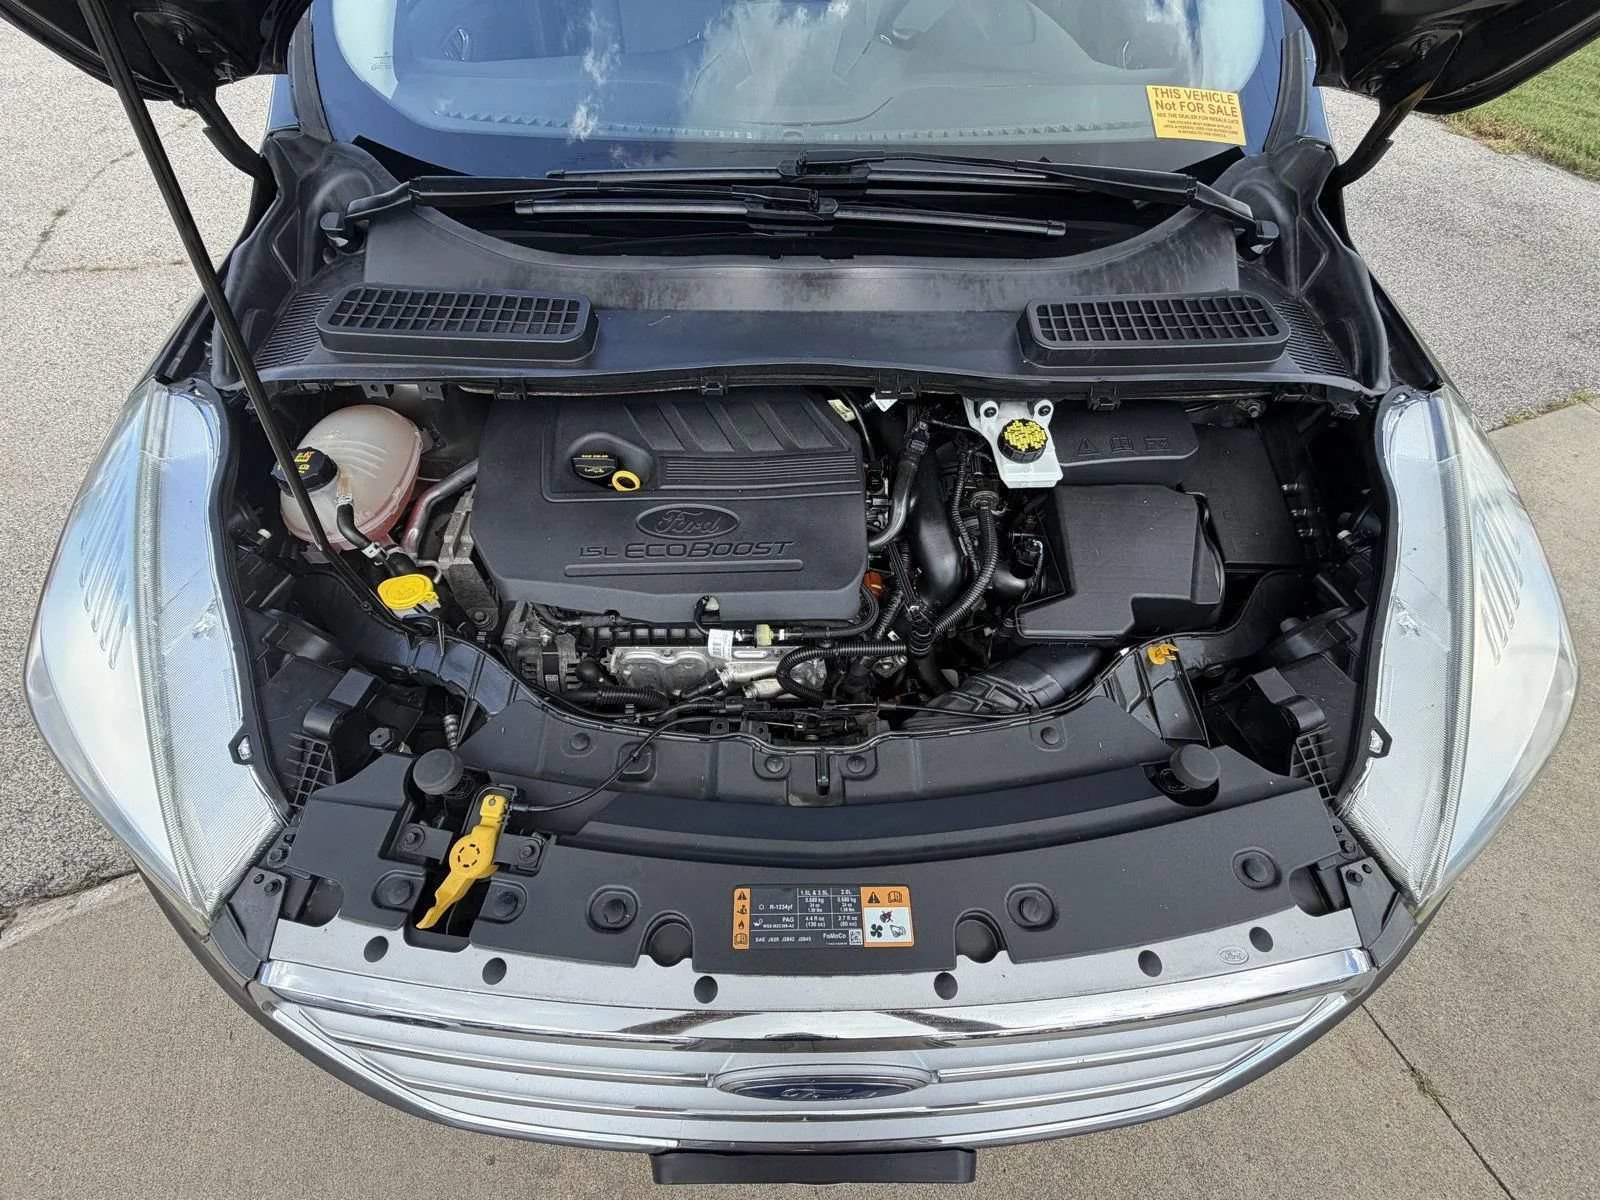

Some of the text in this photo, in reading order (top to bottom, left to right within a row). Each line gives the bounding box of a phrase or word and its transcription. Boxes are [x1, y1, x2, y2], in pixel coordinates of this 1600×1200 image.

[1152, 88, 1235, 105] THIS VEHICLE
[1154, 100, 1238, 117] Not FOR SALE
[654, 509, 722, 534] Ford
[624, 541, 794, 560] ECOBOOST
